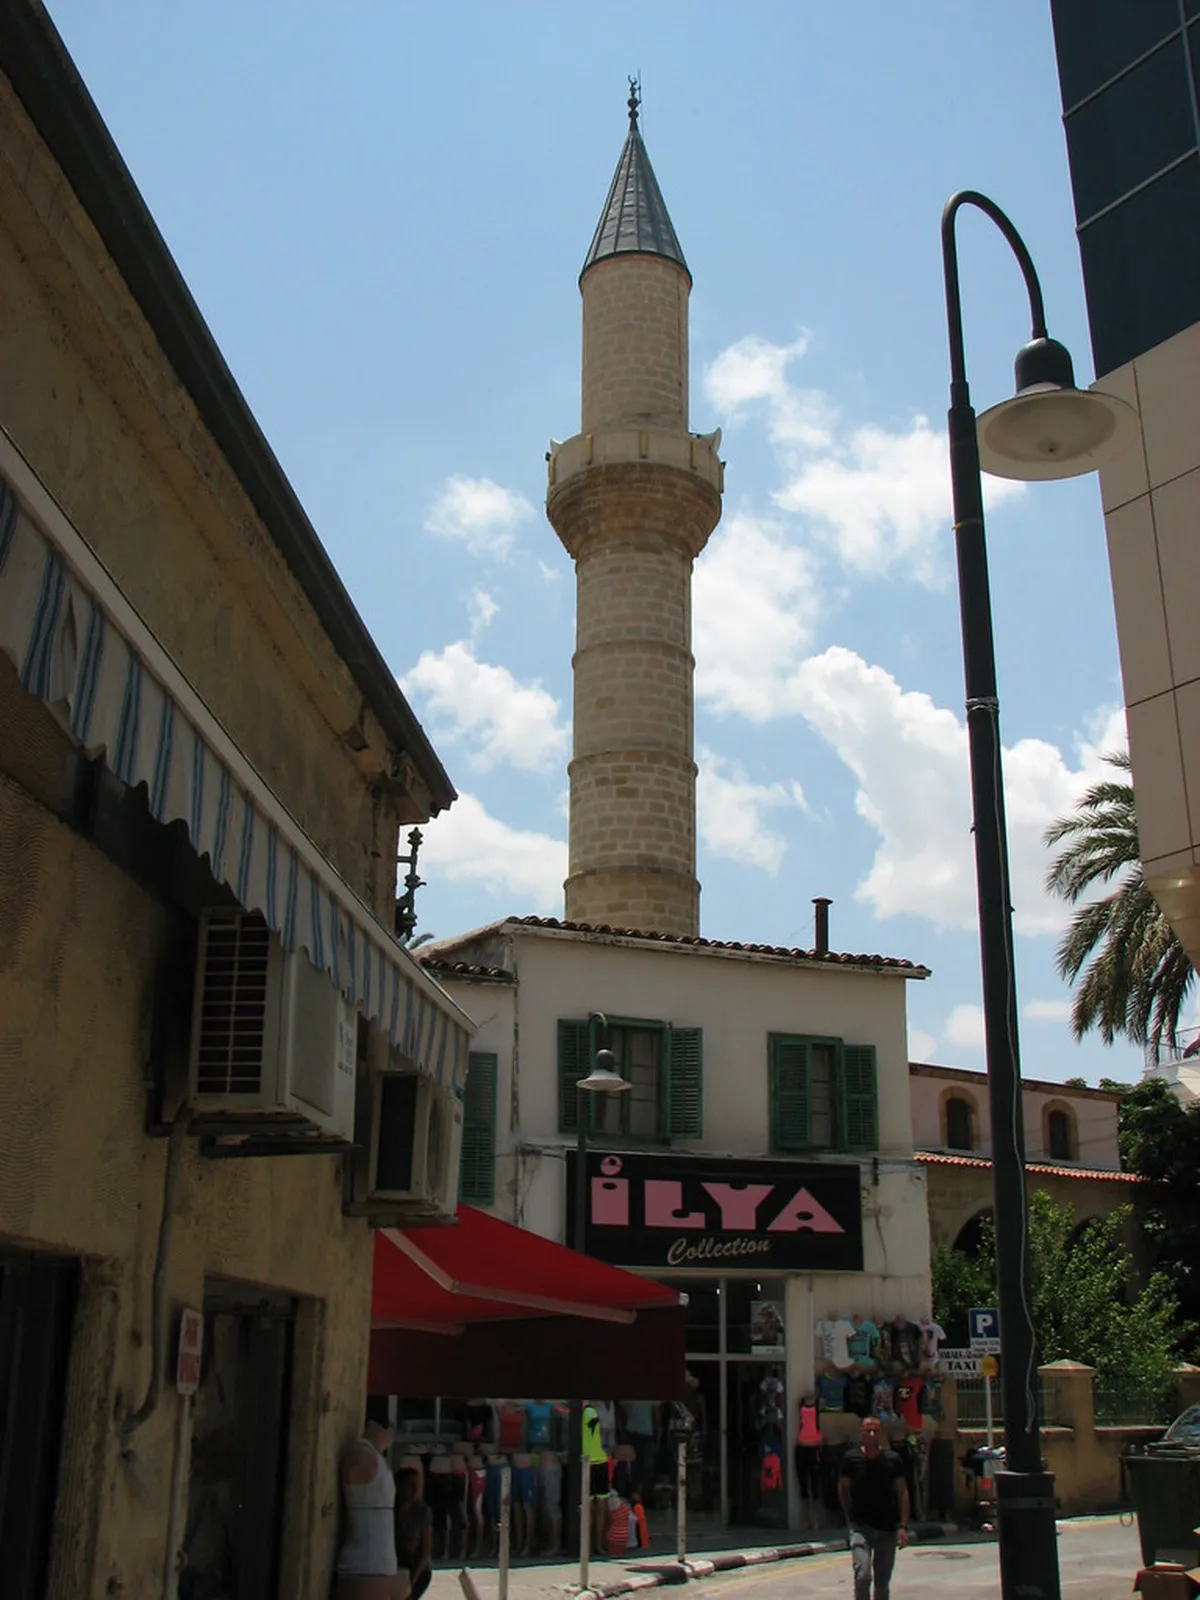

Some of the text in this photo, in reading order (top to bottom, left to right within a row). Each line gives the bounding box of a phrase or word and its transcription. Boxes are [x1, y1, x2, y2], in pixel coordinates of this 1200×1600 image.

[667, 1237, 770, 1265] Collection
[976, 1314, 993, 1333] P
[946, 1360, 977, 1371] TAXI
